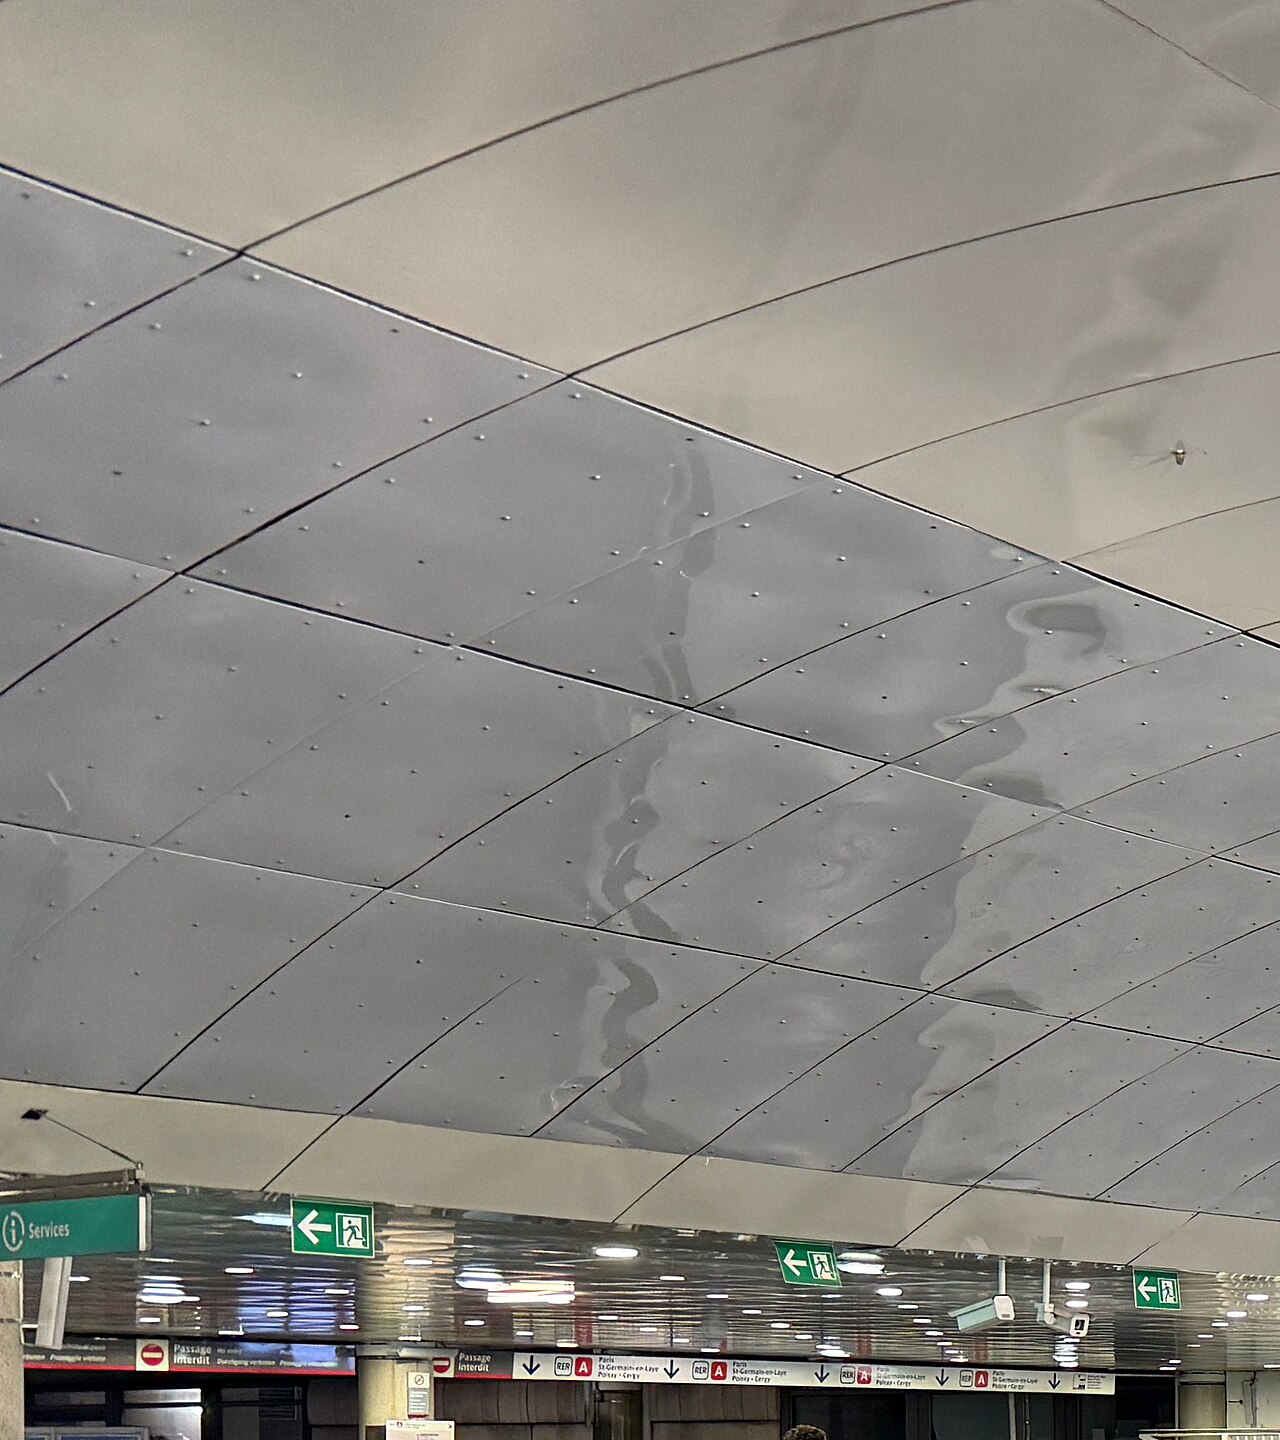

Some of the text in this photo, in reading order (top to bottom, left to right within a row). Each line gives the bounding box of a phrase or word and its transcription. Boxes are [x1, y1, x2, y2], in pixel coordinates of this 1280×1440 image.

[28, 1221, 70, 1239] Services
[173, 1343, 211, 1355] Passage
[173, 1355, 210, 1365] interdit
[459, 1352, 492, 1364] Passage
[458, 1362, 489, 1373] interdit
[557, 1362, 570, 1370] RER
[695, 1366, 707, 1374] RER
[732, 1367, 787, 1377] St-Germain-en-Laye
[842, 1371, 854, 1379] RER
